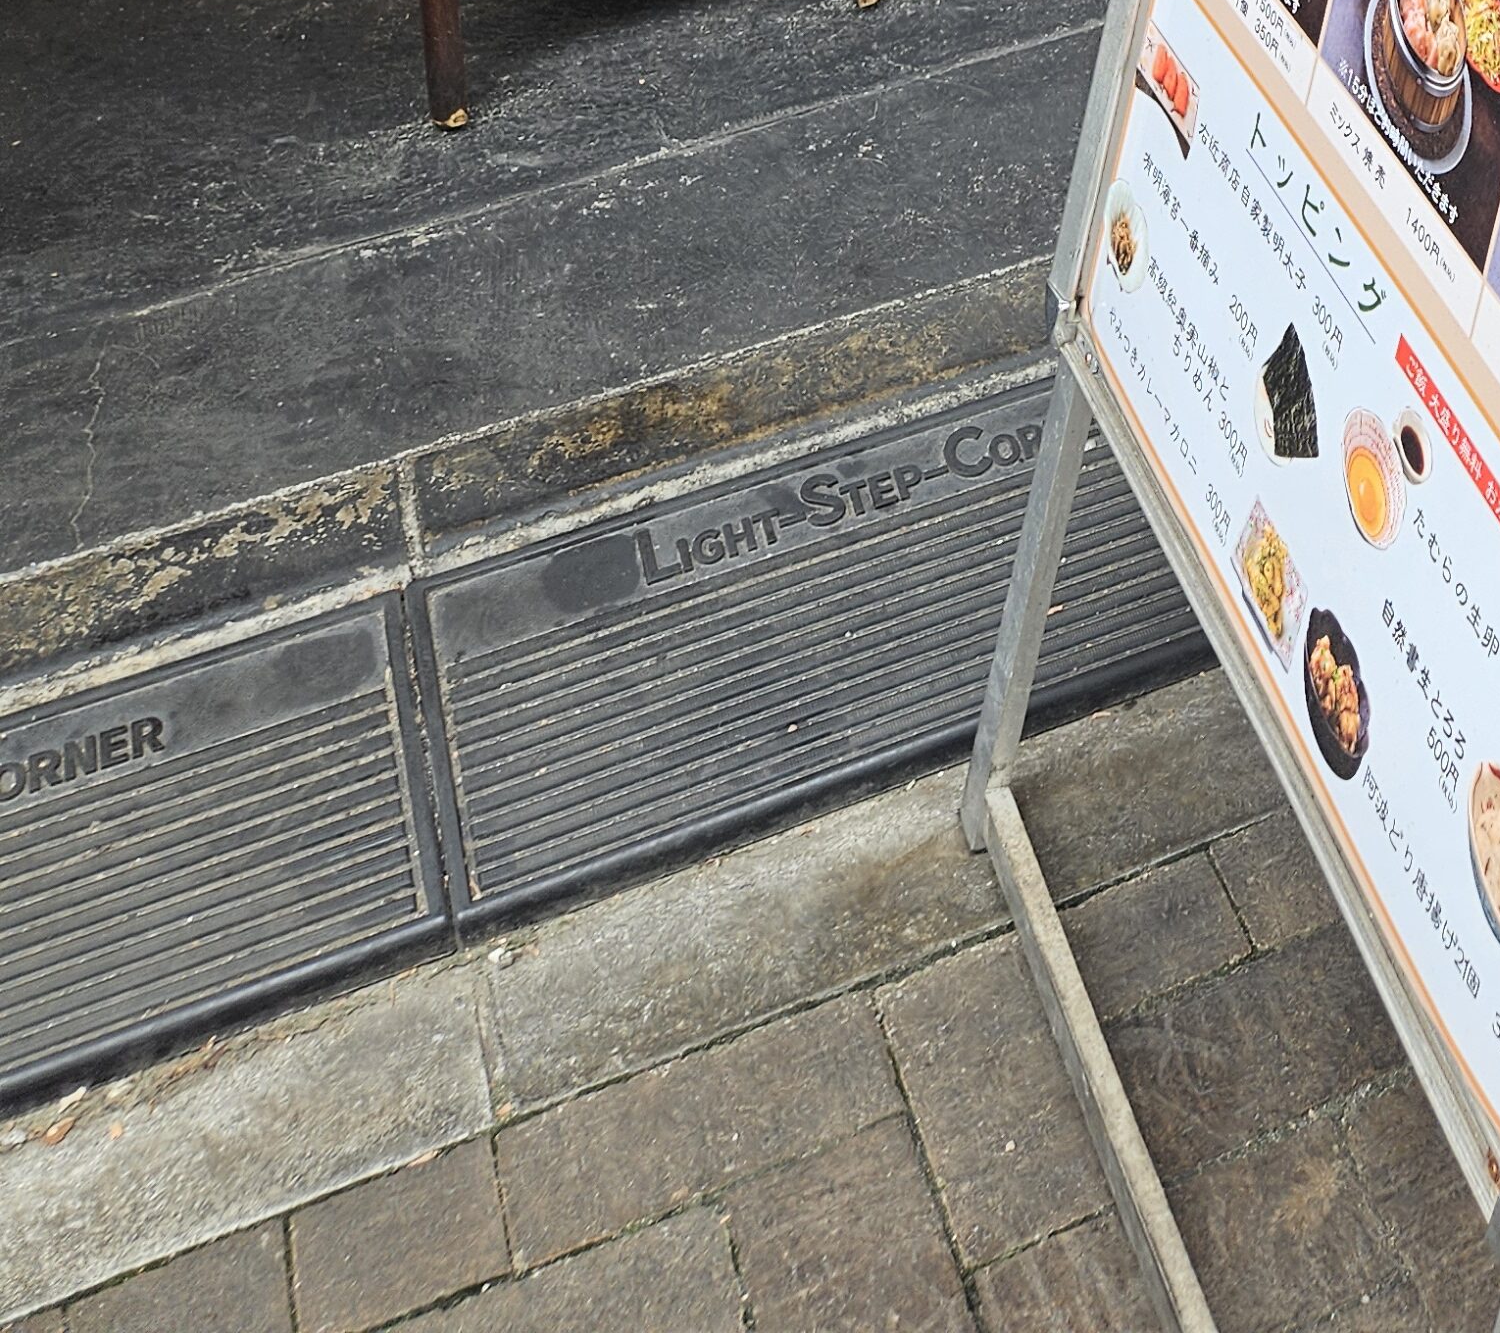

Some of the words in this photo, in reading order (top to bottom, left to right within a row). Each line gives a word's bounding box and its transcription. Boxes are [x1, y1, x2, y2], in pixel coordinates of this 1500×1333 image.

[1254, 17, 1280, 58] 350円
[1250, 111, 1387, 313] トッピング
[1406, 207, 1440, 266] 1400円
[1228, 294, 1259, 348] 200円
[1312, 295, 1343, 354] 300円
[1172, 334, 1213, 413] ちりめん
[1217, 410, 1248, 473] 300円
[1205, 483, 1232, 536] 300円
[1412, 508, 1500, 658] たむらの生卵
[1426, 725, 1460, 793] 500円
[1362, 764, 1481, 1000] 阿波どり唐揚げ2個
